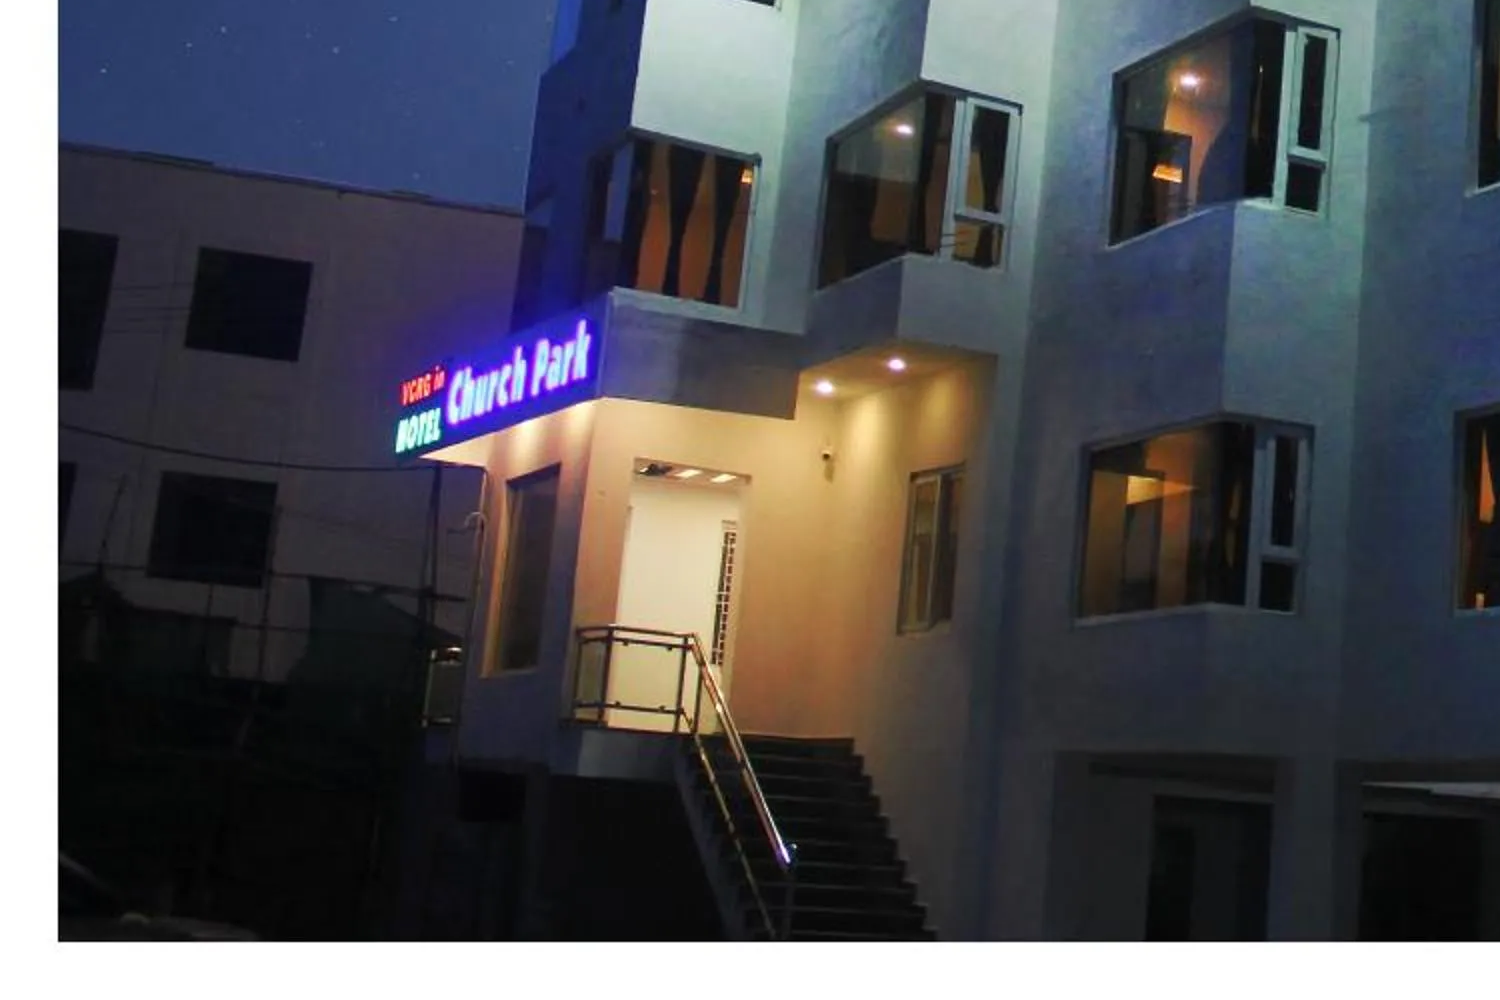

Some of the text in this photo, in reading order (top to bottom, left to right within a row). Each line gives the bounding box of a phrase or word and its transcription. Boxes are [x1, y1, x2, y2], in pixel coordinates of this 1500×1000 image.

[401, 373, 431, 406] VCRG
[447, 318, 591, 424] Church Park
[395, 407, 442, 454] HOTEL
